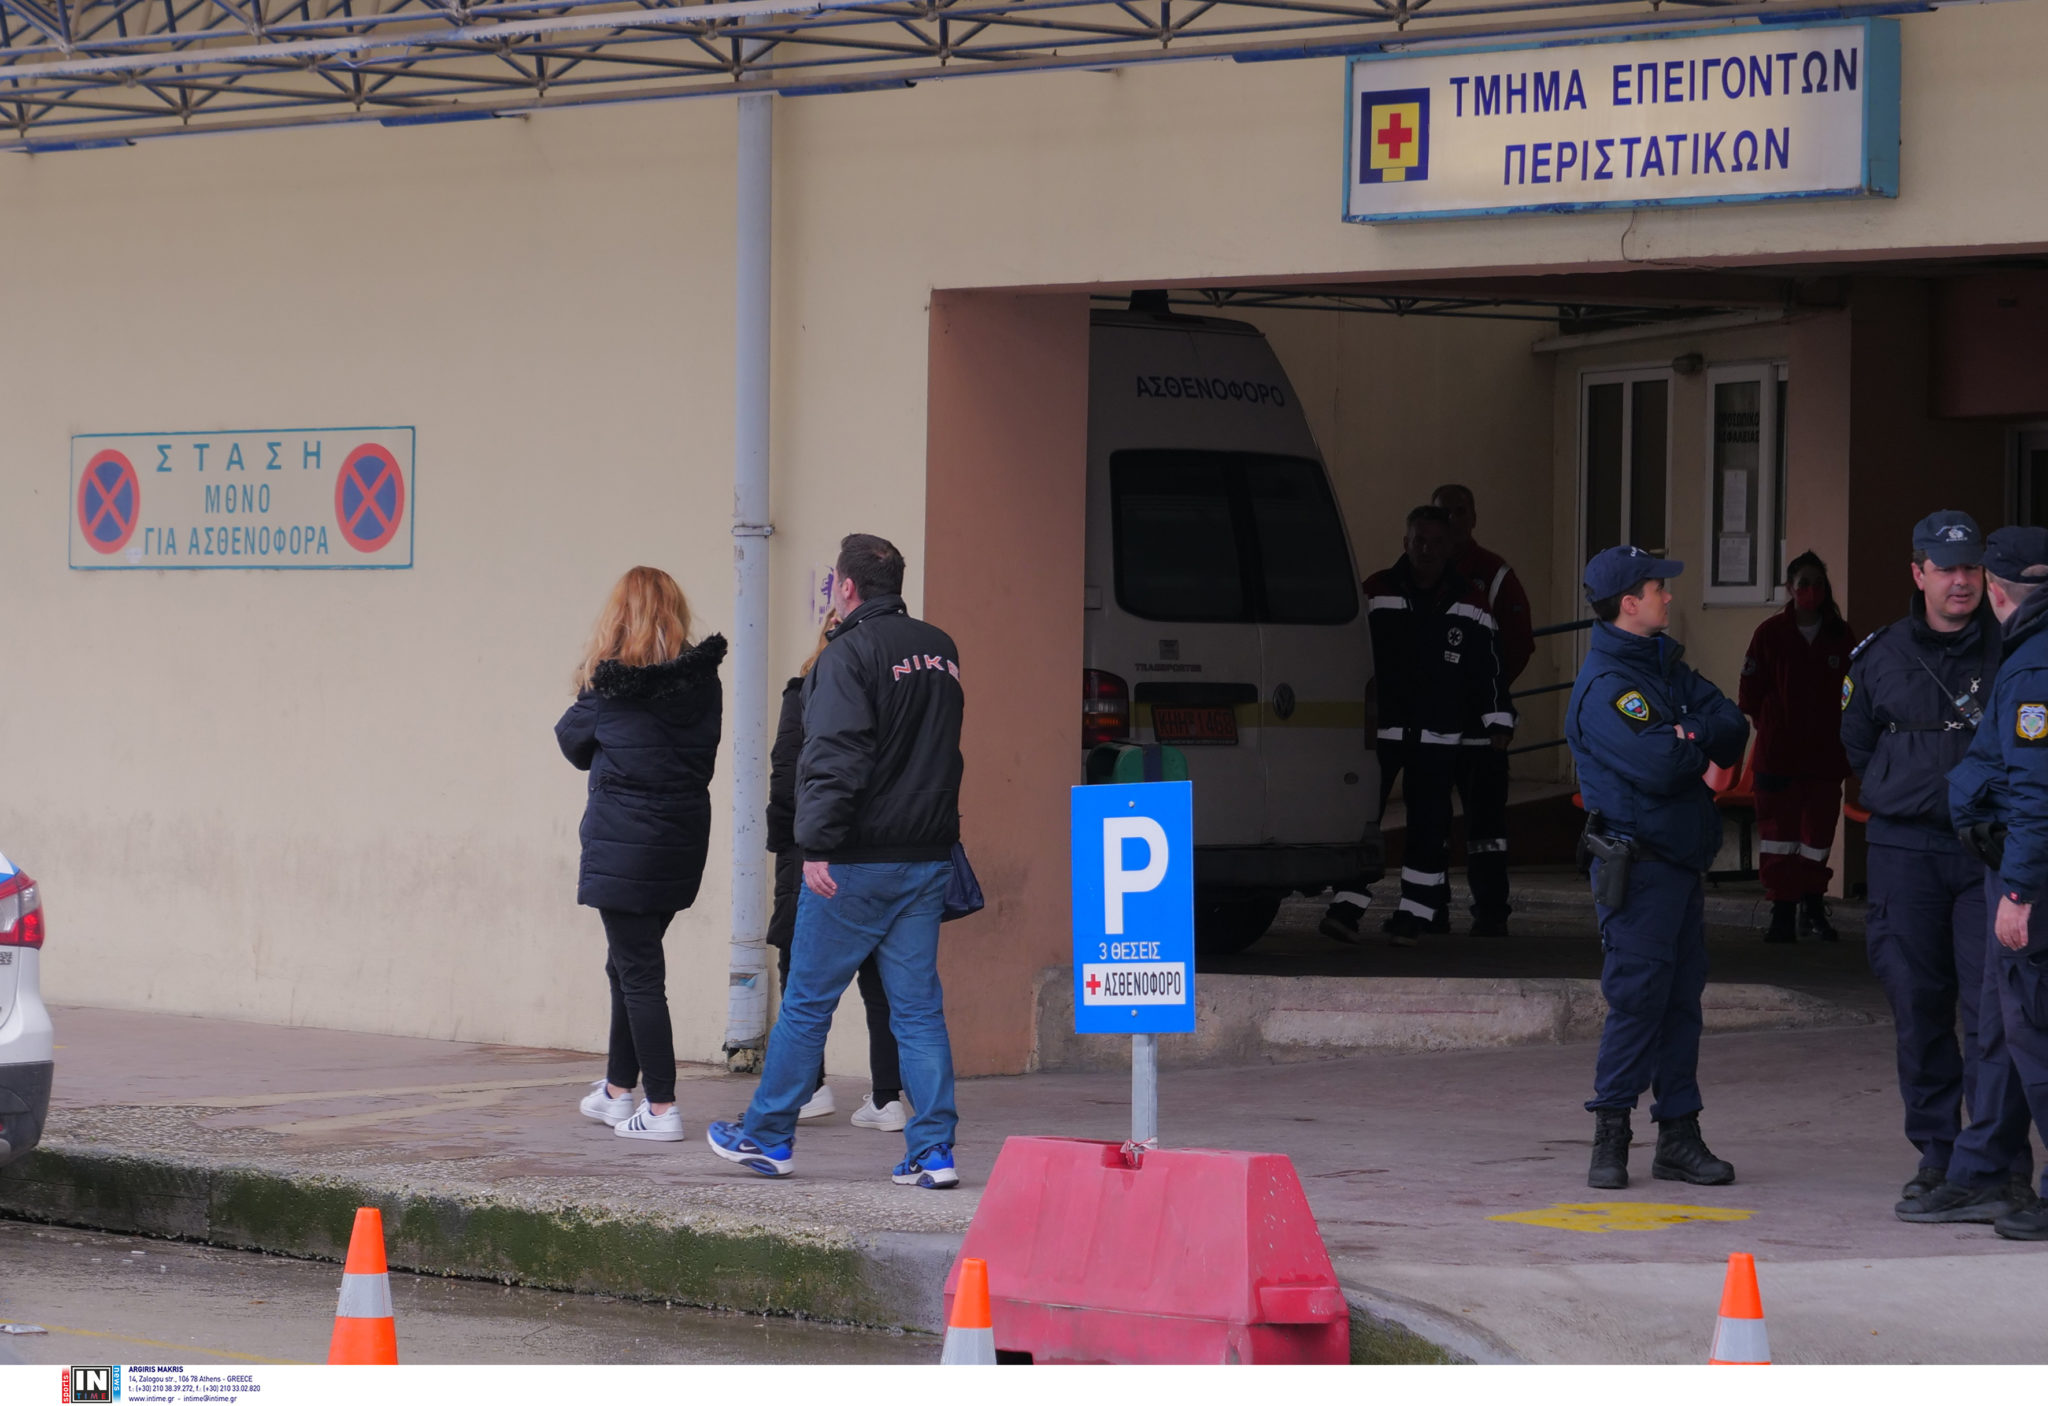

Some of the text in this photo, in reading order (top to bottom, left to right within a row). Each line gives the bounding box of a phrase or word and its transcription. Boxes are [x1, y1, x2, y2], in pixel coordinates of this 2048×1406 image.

[1450, 47, 1858, 118] ΤΜΗΜΑ ΕΠΕΙΓΟΝΤΩΝ
[1503, 126, 1789, 186] ΠΕΡΙΣΤΑΤΙΚΩΝ
[1137, 375, 1285, 407] ΑΣΘΕΝΟΦΟΡΟ
[156, 440, 322, 473] ΣΤΑΣΗ
[144, 525, 329, 556] ΓΙΑ ΑΣΘΕΝΟΦΟΡΑ
[1103, 816, 1169, 935] P
[1098, 941, 1161, 960] 3 ΘΕΣΕΙΣ
[1104, 971, 1181, 997] ΑΣΘΕΝΟΦΟΡΟ
